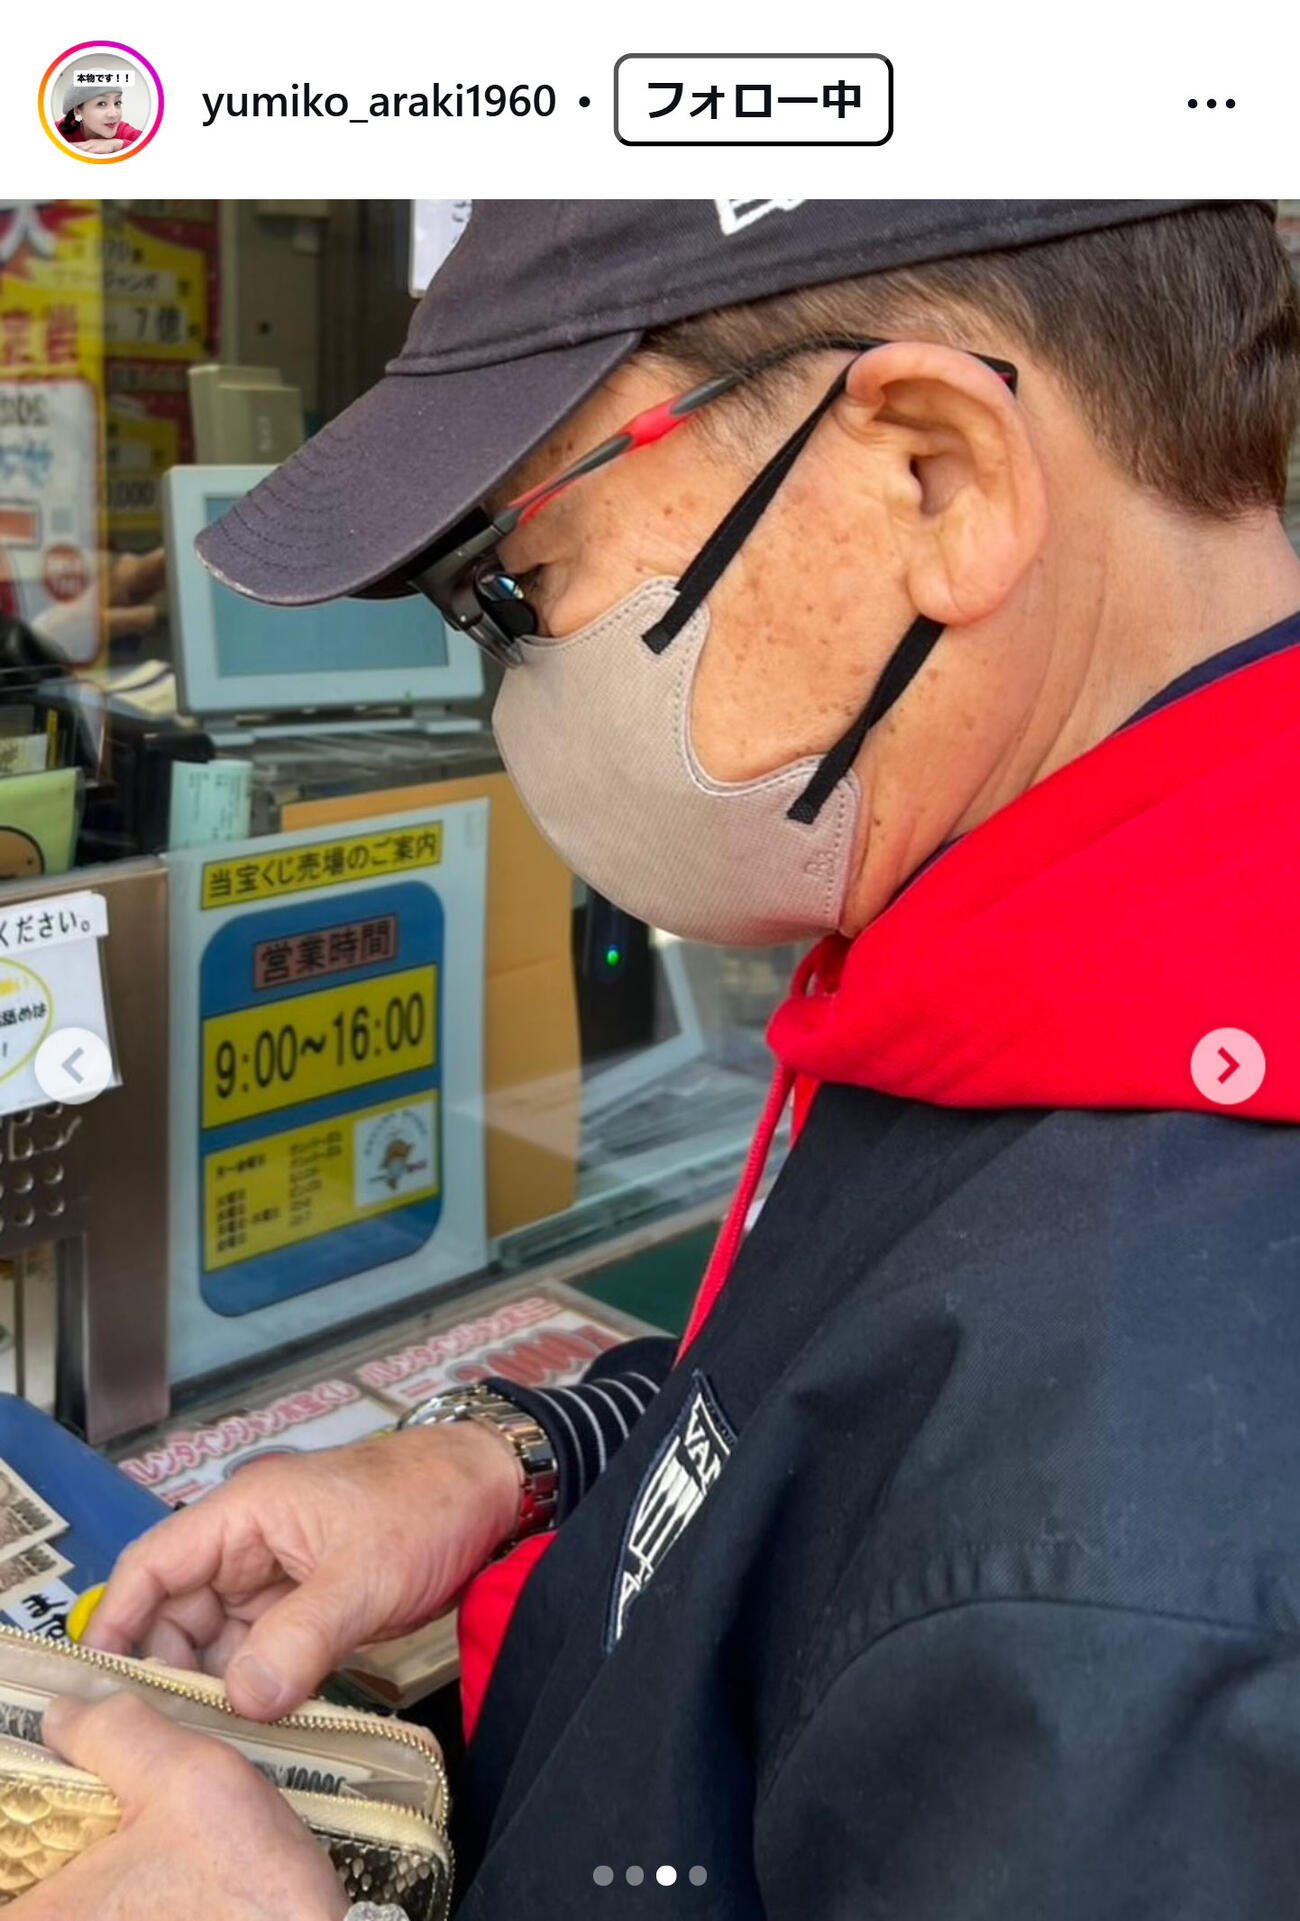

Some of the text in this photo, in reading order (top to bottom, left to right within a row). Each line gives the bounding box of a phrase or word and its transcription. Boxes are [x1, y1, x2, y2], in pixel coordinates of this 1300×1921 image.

[208, 831, 437, 899] 当宝くじ売場のご案内
[261, 918, 393, 984] 営業時間
